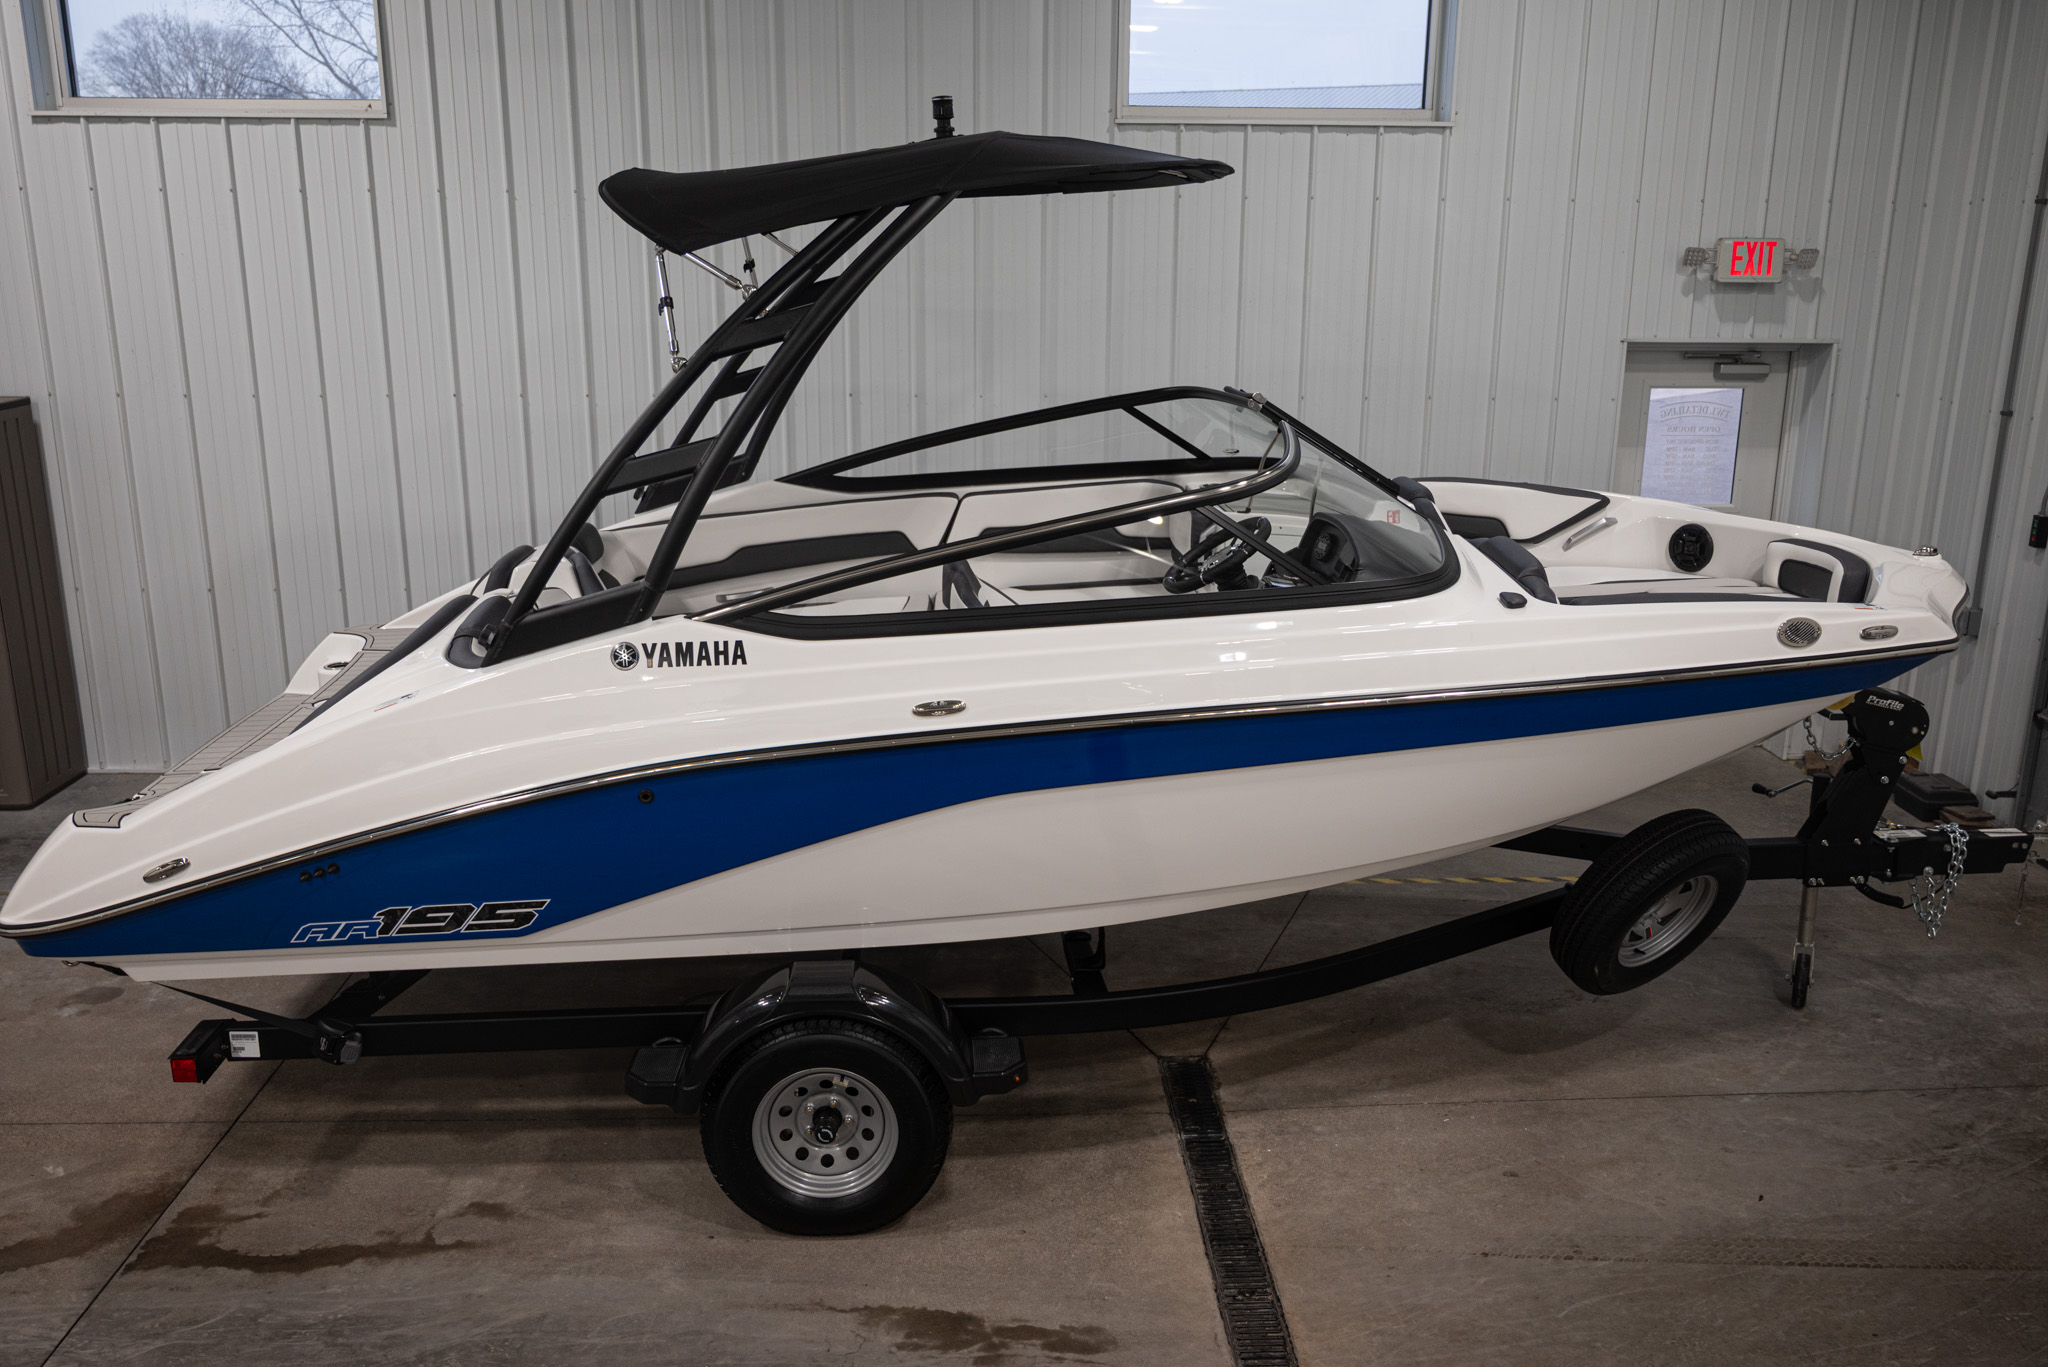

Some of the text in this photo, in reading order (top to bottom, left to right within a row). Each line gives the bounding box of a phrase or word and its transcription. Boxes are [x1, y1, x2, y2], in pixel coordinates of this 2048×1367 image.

[1730, 241, 1778, 276] EXIT
[641, 640, 748, 668] YAMAHA
[1867, 695, 1905, 709] Profile
